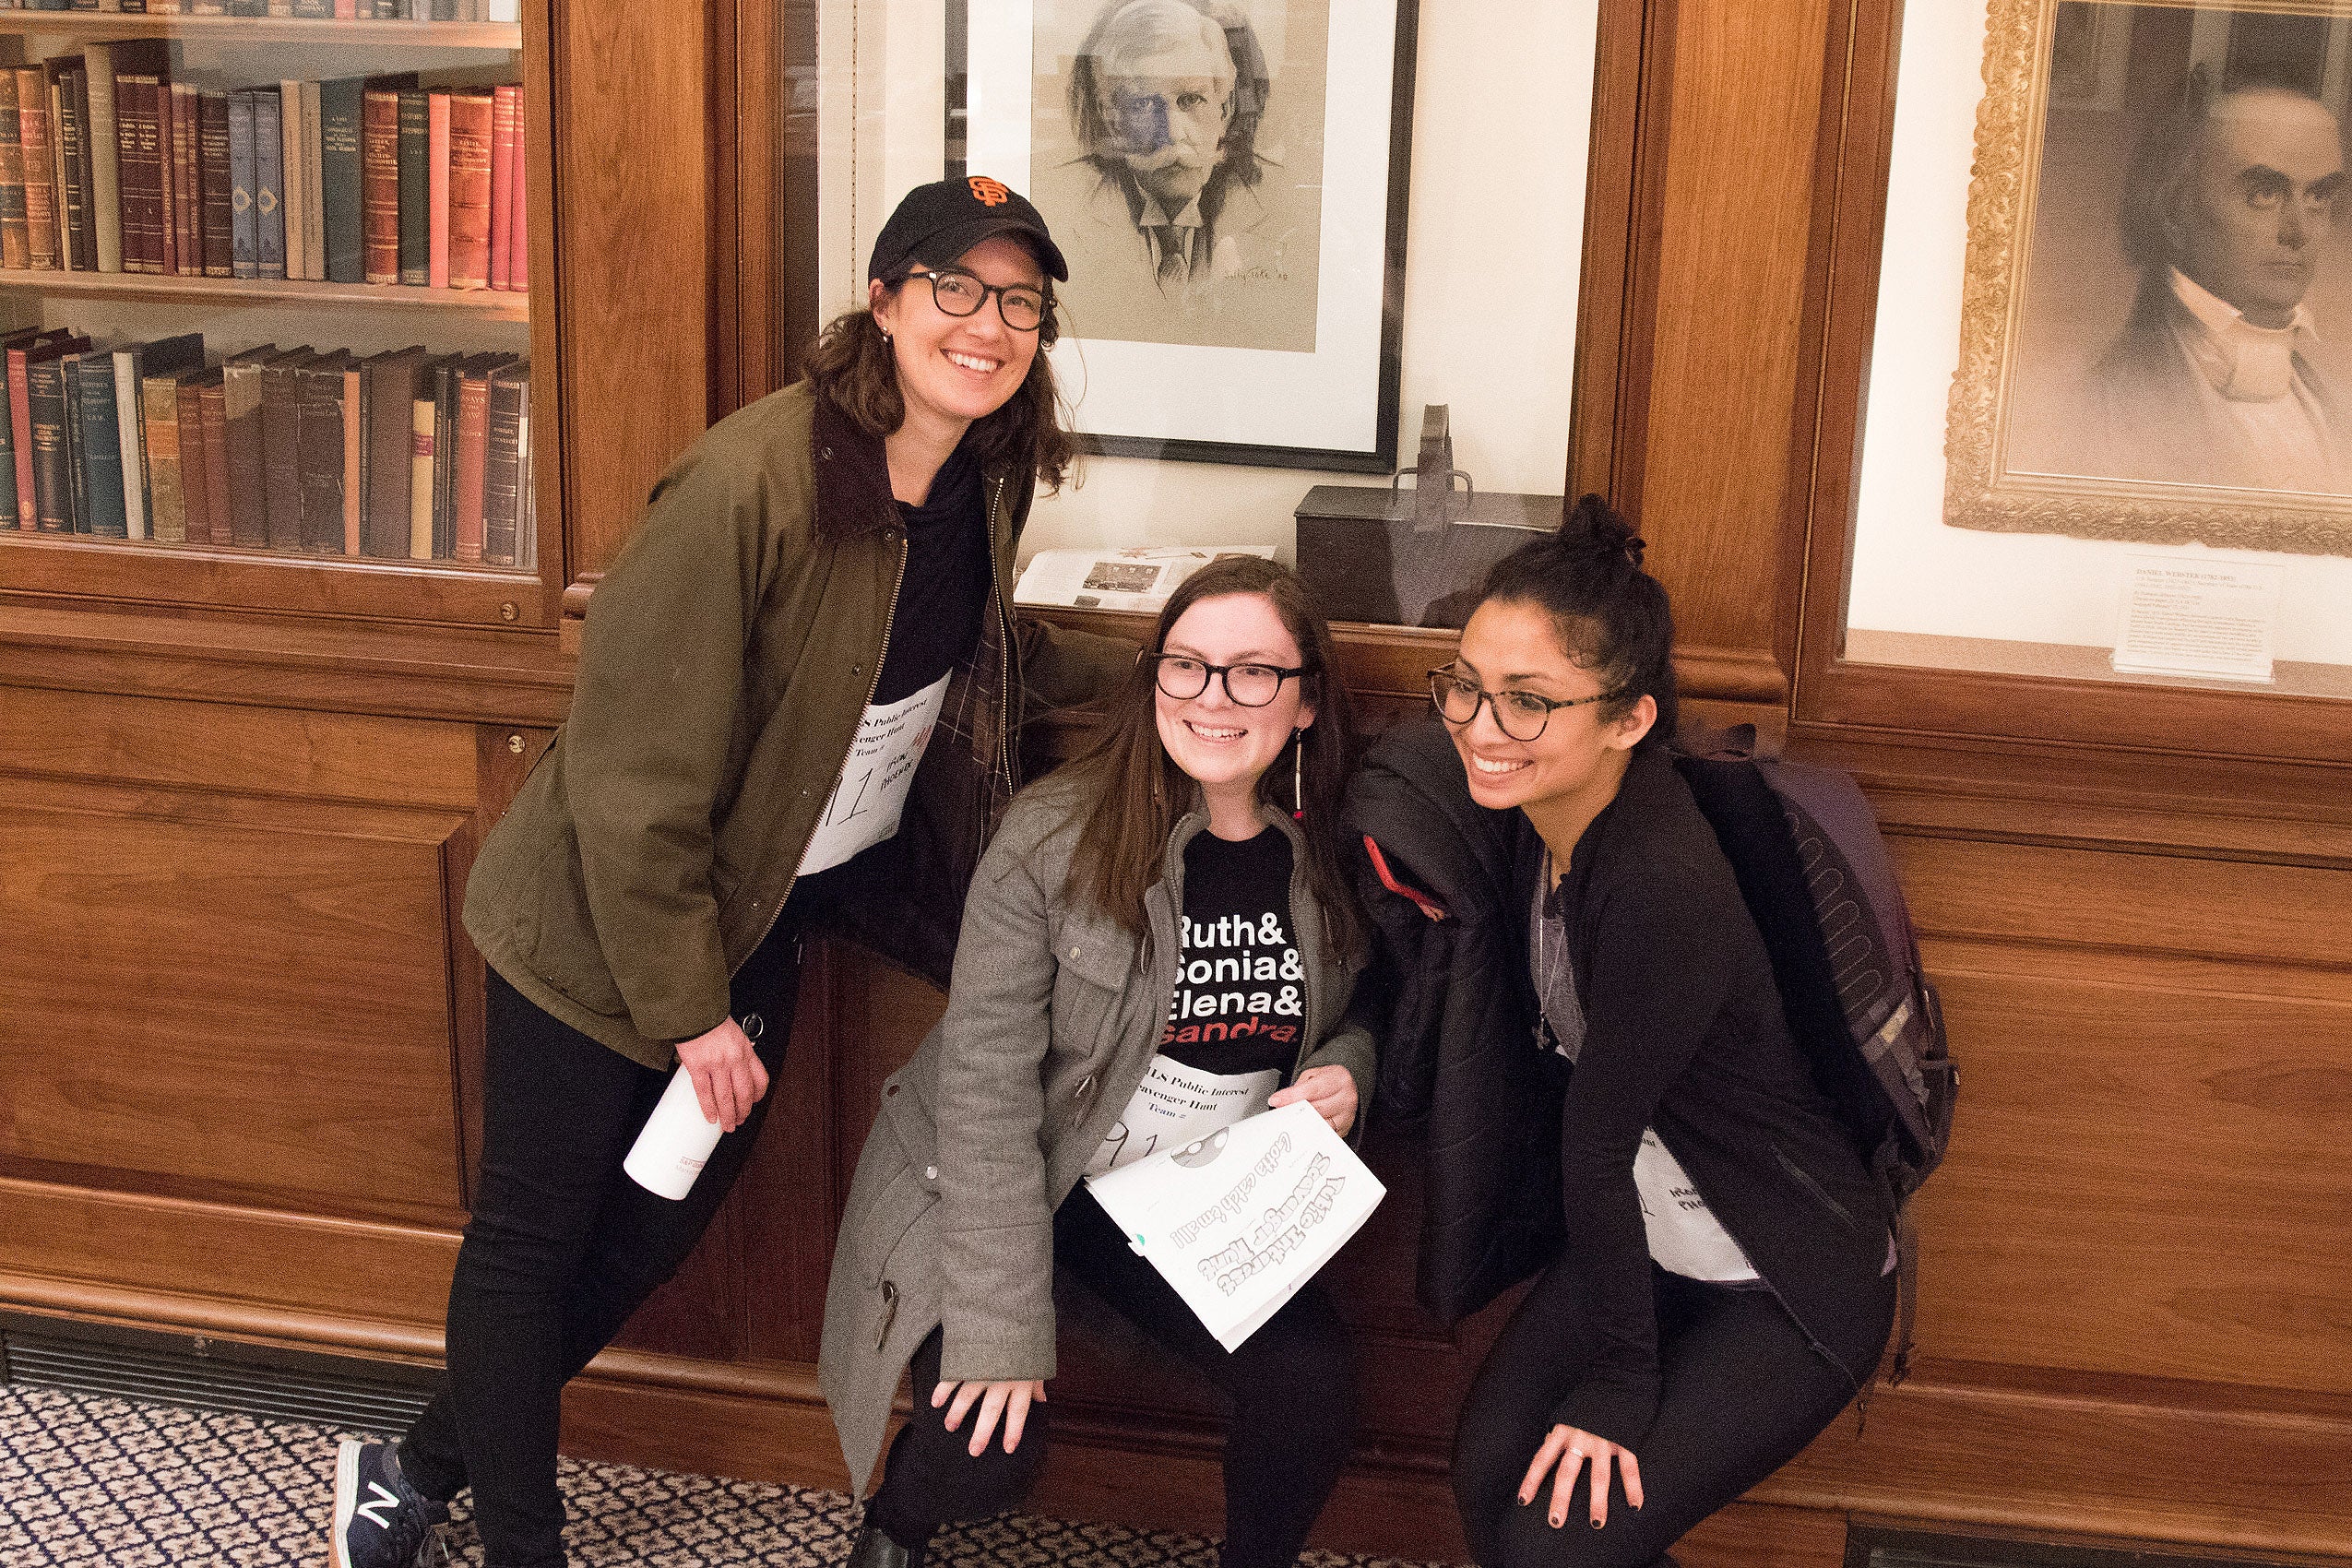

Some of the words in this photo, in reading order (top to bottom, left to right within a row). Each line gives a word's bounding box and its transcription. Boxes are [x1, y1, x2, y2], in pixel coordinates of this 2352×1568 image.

[968, 176, 1009, 207] SF
[873, 714, 901, 728] Public
[901, 698, 928, 719] Interest
[886, 722, 906, 738] Hunt
[855, 748, 878, 757] Team
[1170, 1076, 1209, 1096] Public
[1211, 1087, 1249, 1098] Interest
[1148, 1101, 1177, 1119] Team
[1189, 1099, 1218, 1112] Hunt
[357, 1480, 400, 1529] N
